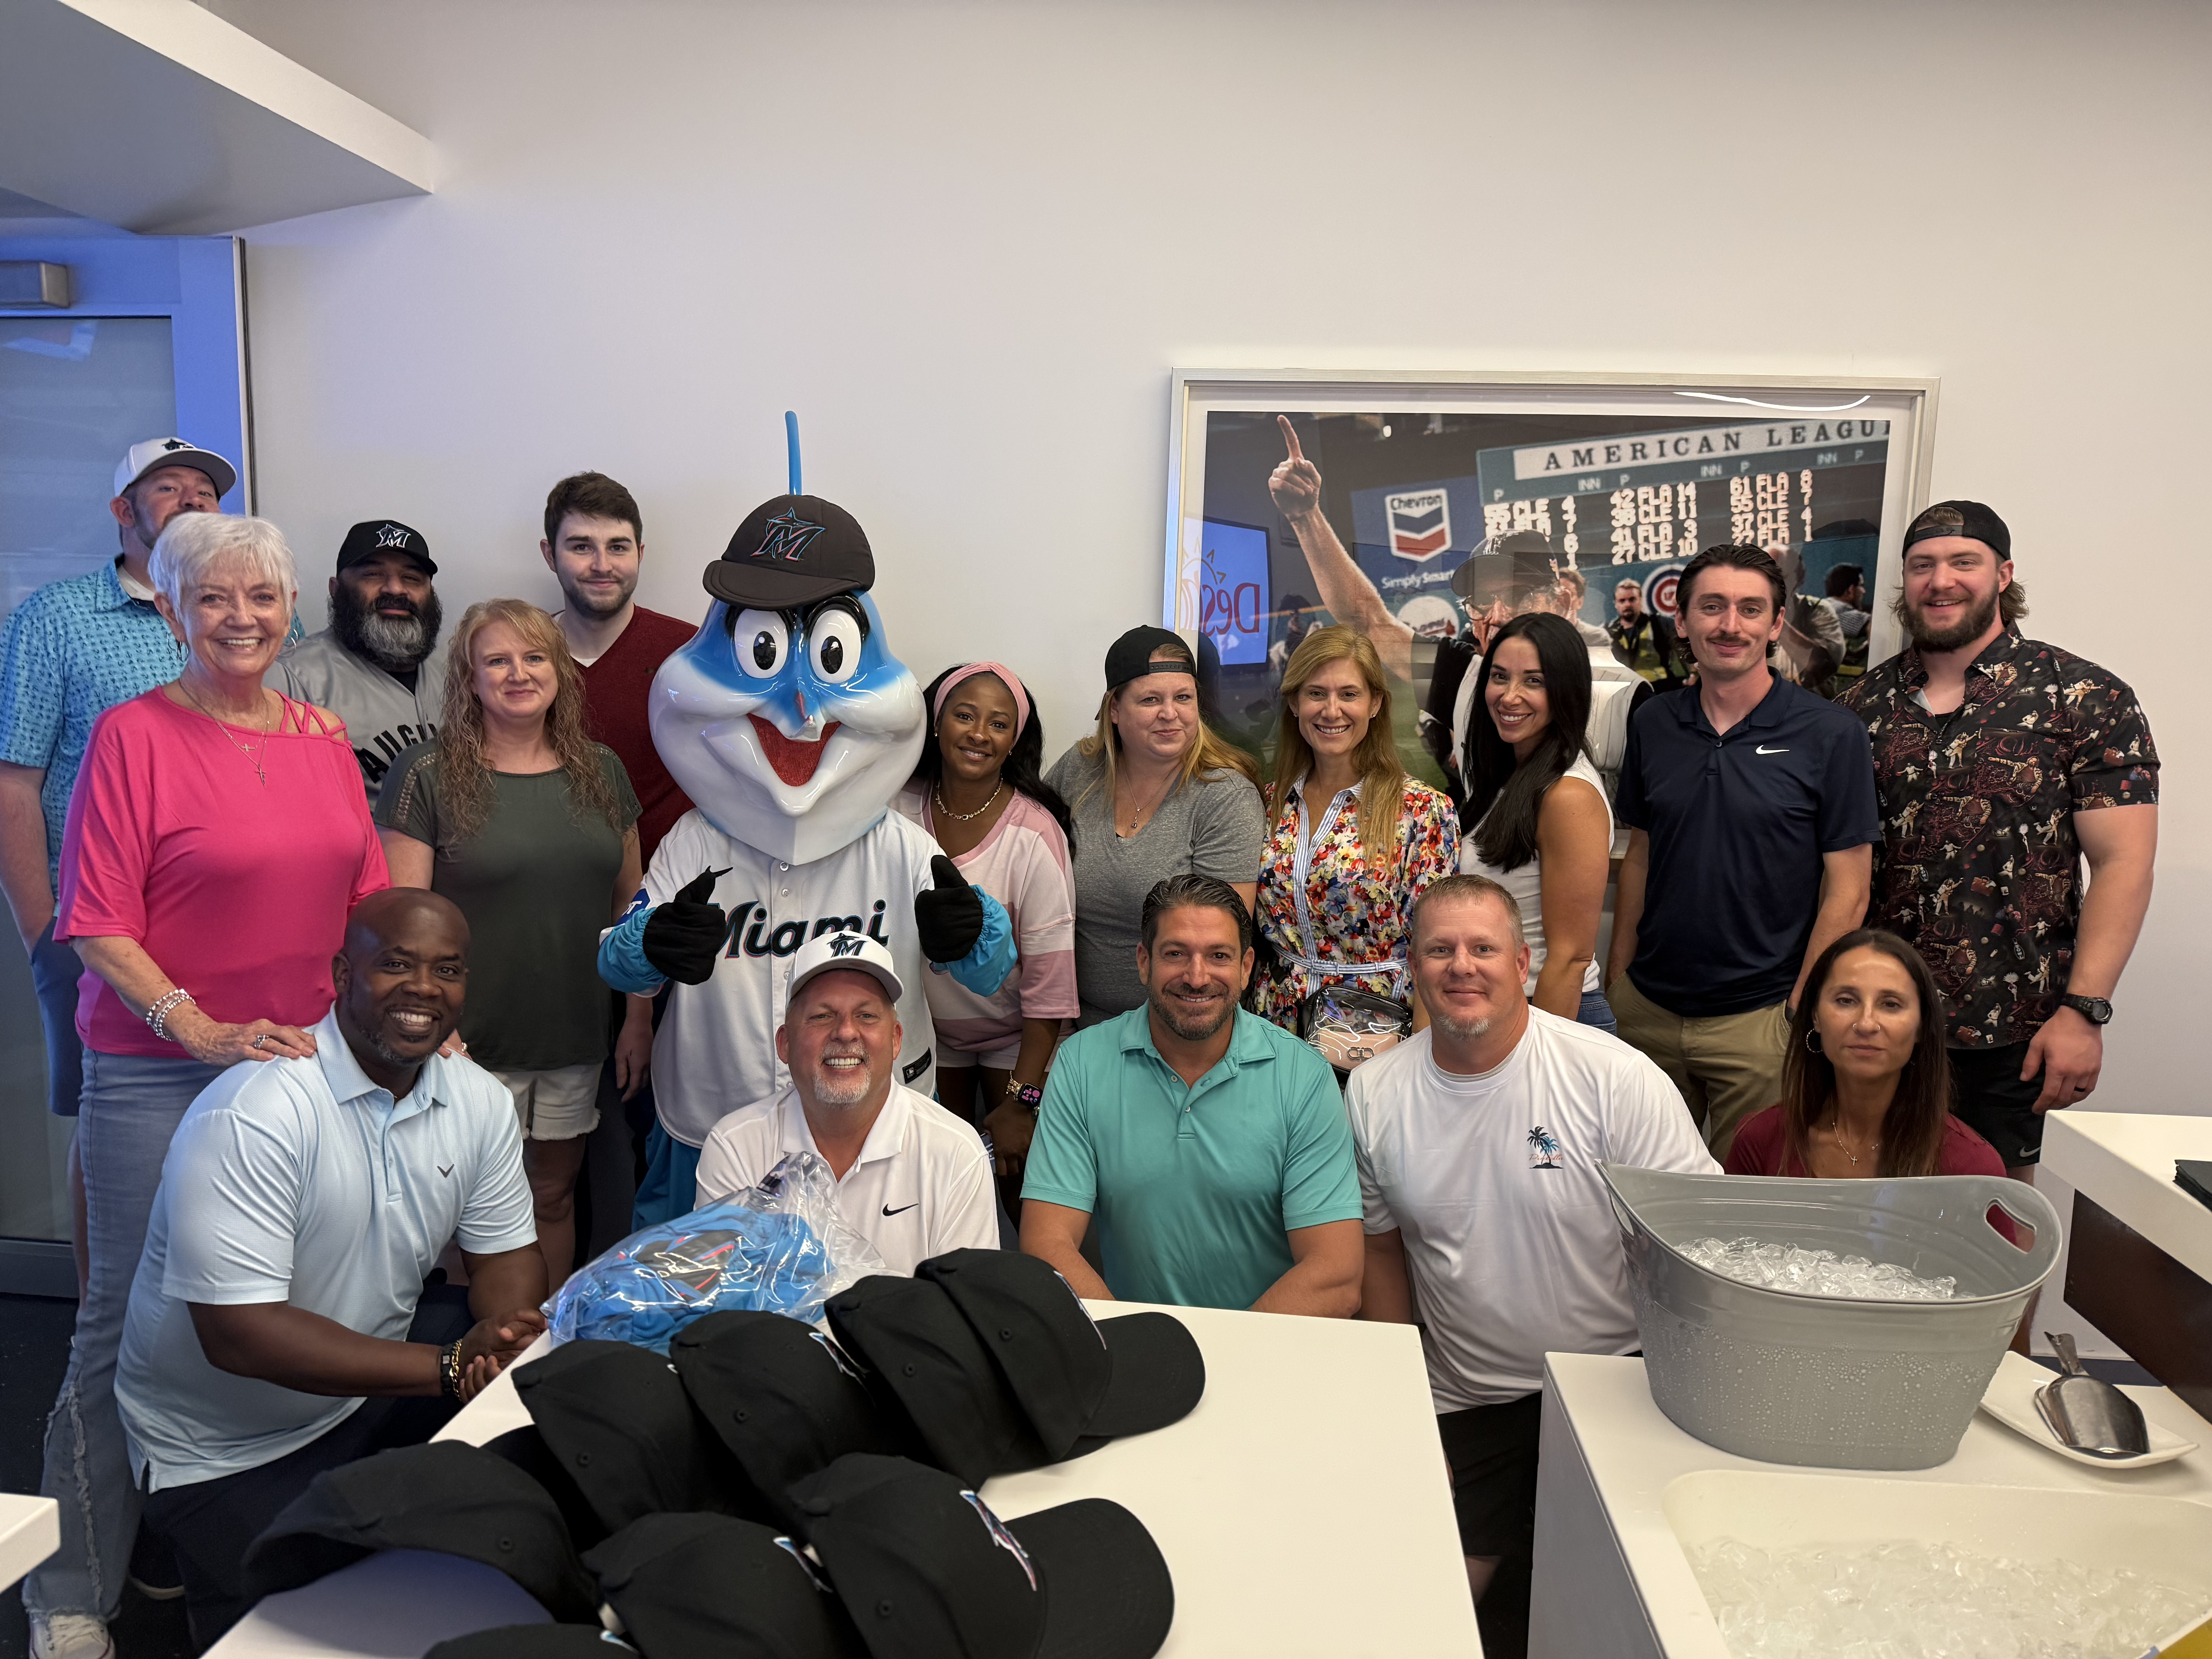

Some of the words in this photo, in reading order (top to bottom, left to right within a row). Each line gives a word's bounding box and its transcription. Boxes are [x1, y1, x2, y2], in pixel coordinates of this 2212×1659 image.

[1544, 431, 1741, 471] AMERICAN
[1494, 489, 1504, 502] P
[1620, 473, 1630, 486] P
[1740, 461, 1750, 473] P
[1855, 450, 1863, 462] P
[1730, 476, 1753, 496] 61
[1756, 472, 1789, 493] FLA
[1801, 469, 1812, 488] 8
[1391, 495, 1442, 510] Chevron
[1513, 498, 1550, 520] CLE
[1562, 495, 1575, 514] 4
[1610, 488, 1635, 509] 42
[1637, 484, 1672, 507] FLA
[1677, 481, 1697, 502] 14
[1731, 494, 1754, 514] 55
[1757, 490, 1789, 510] CLE
[1801, 488, 1812, 505] 7
[1562, 514, 1577, 532] 7
[1611, 508, 1636, 527] 38
[1638, 503, 1673, 524] CLE
[1678, 501, 1697, 520] 11
[1731, 512, 1754, 533] 37
[1757, 509, 1790, 529] CLE
[1801, 506, 1813, 525] 4
[1564, 533, 1578, 553] 6
[1611, 527, 1635, 546] 41
[1637, 522, 1673, 544] FLA
[1684, 519, 1697, 538] 3
[1805, 525, 1813, 542] 1
[1611, 544, 1636, 565] 27
[1638, 541, 1673, 561] CLE
[1678, 538, 1698, 557] 10
[1381, 574, 1421, 589] Simply
